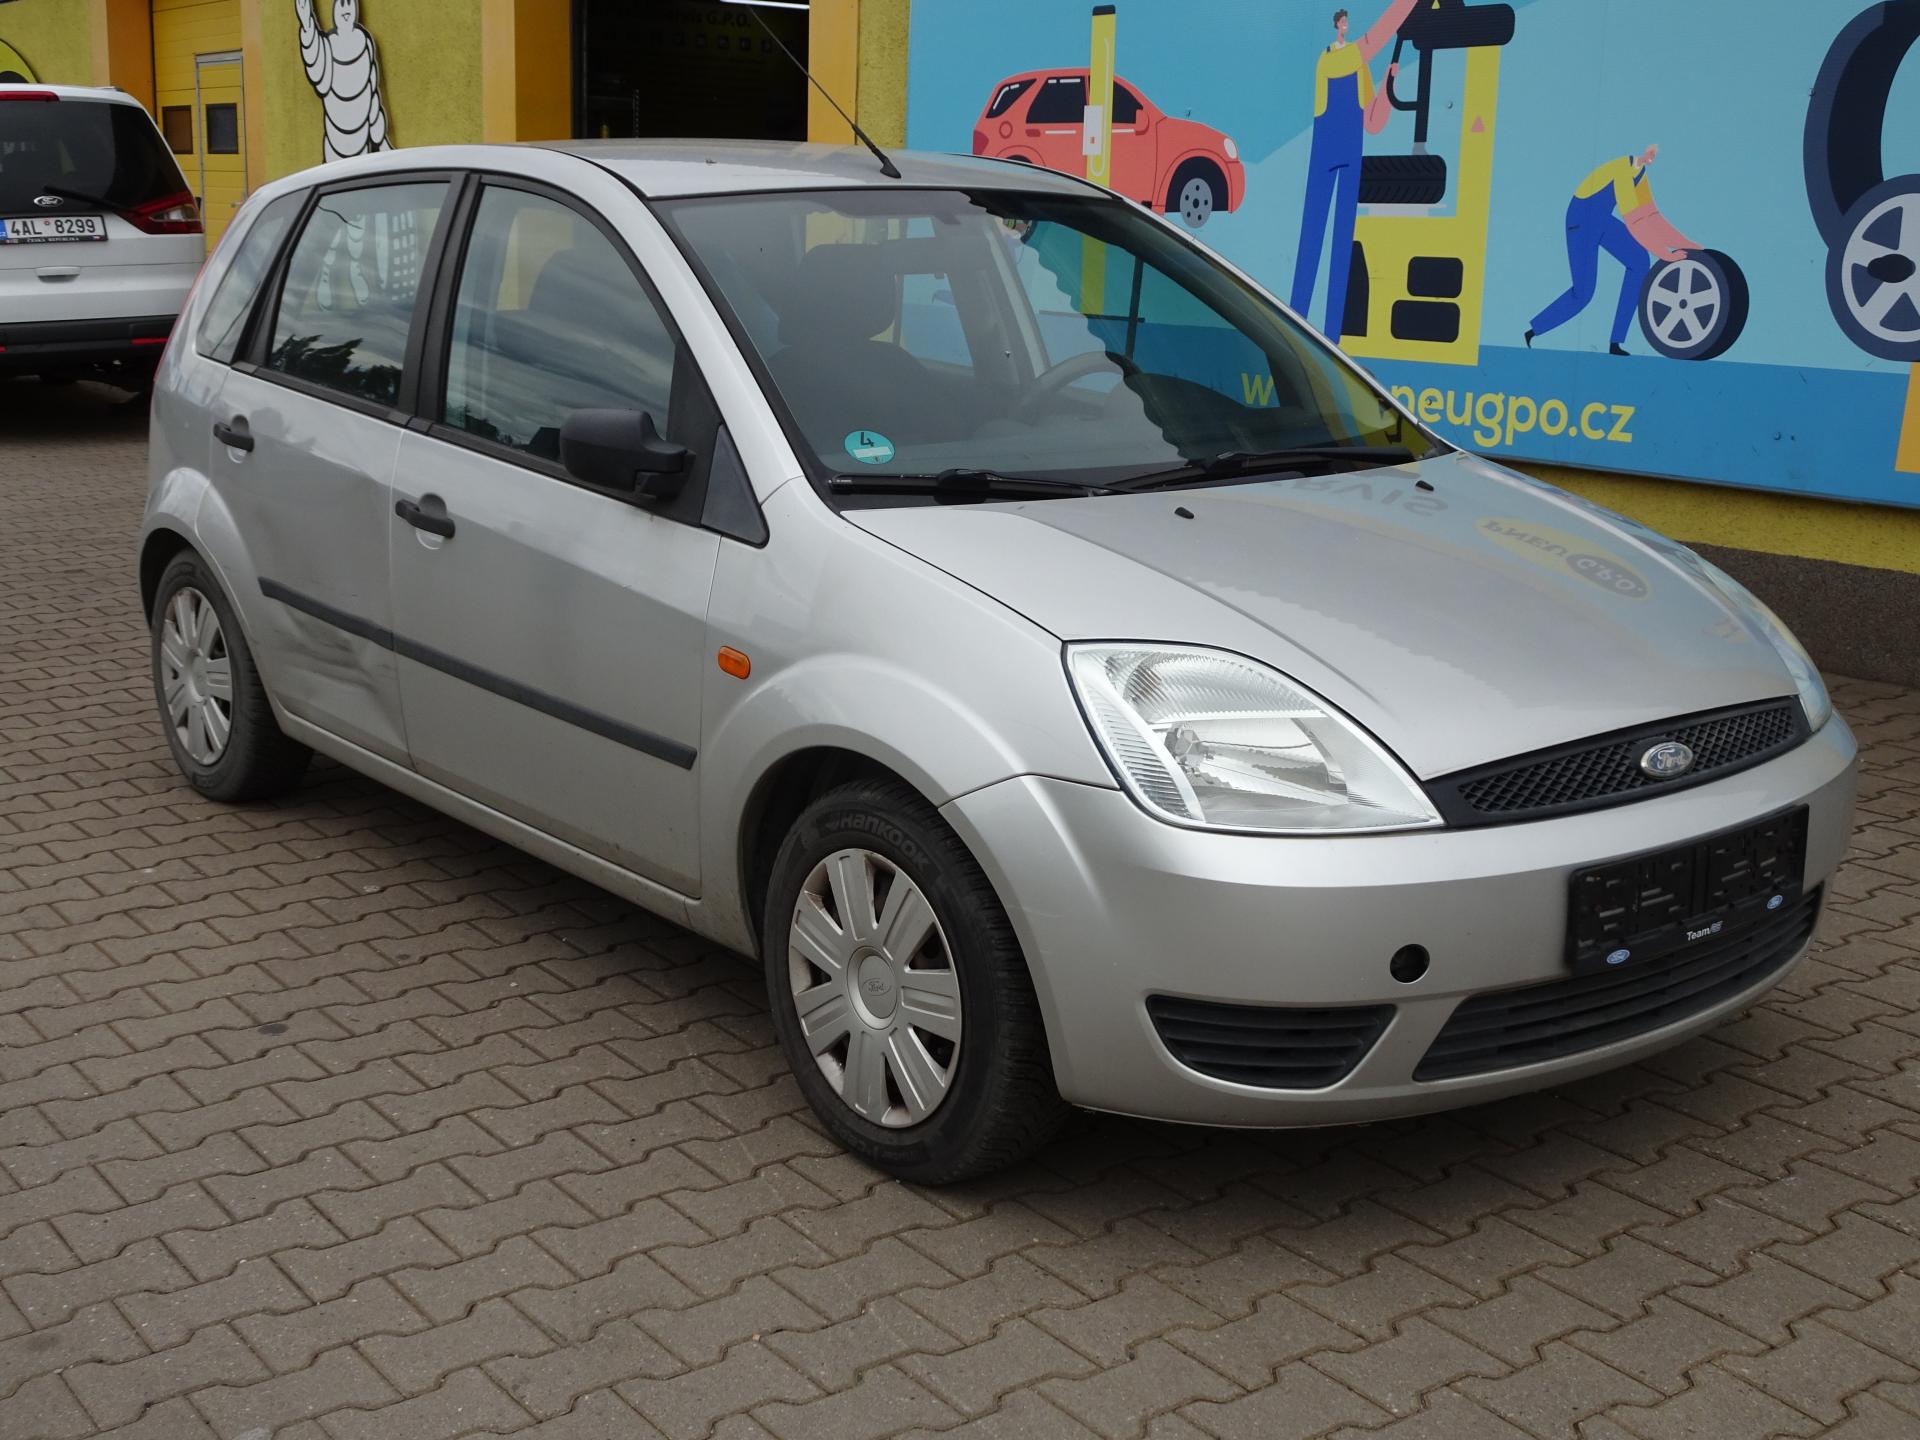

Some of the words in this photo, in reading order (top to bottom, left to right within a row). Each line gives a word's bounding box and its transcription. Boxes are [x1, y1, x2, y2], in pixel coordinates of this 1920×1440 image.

[11, 221, 43, 236] 4AL
[54, 219, 96, 234] 8299
[1656, 748, 1687, 770] Ford
[1686, 927, 1711, 941] Team
